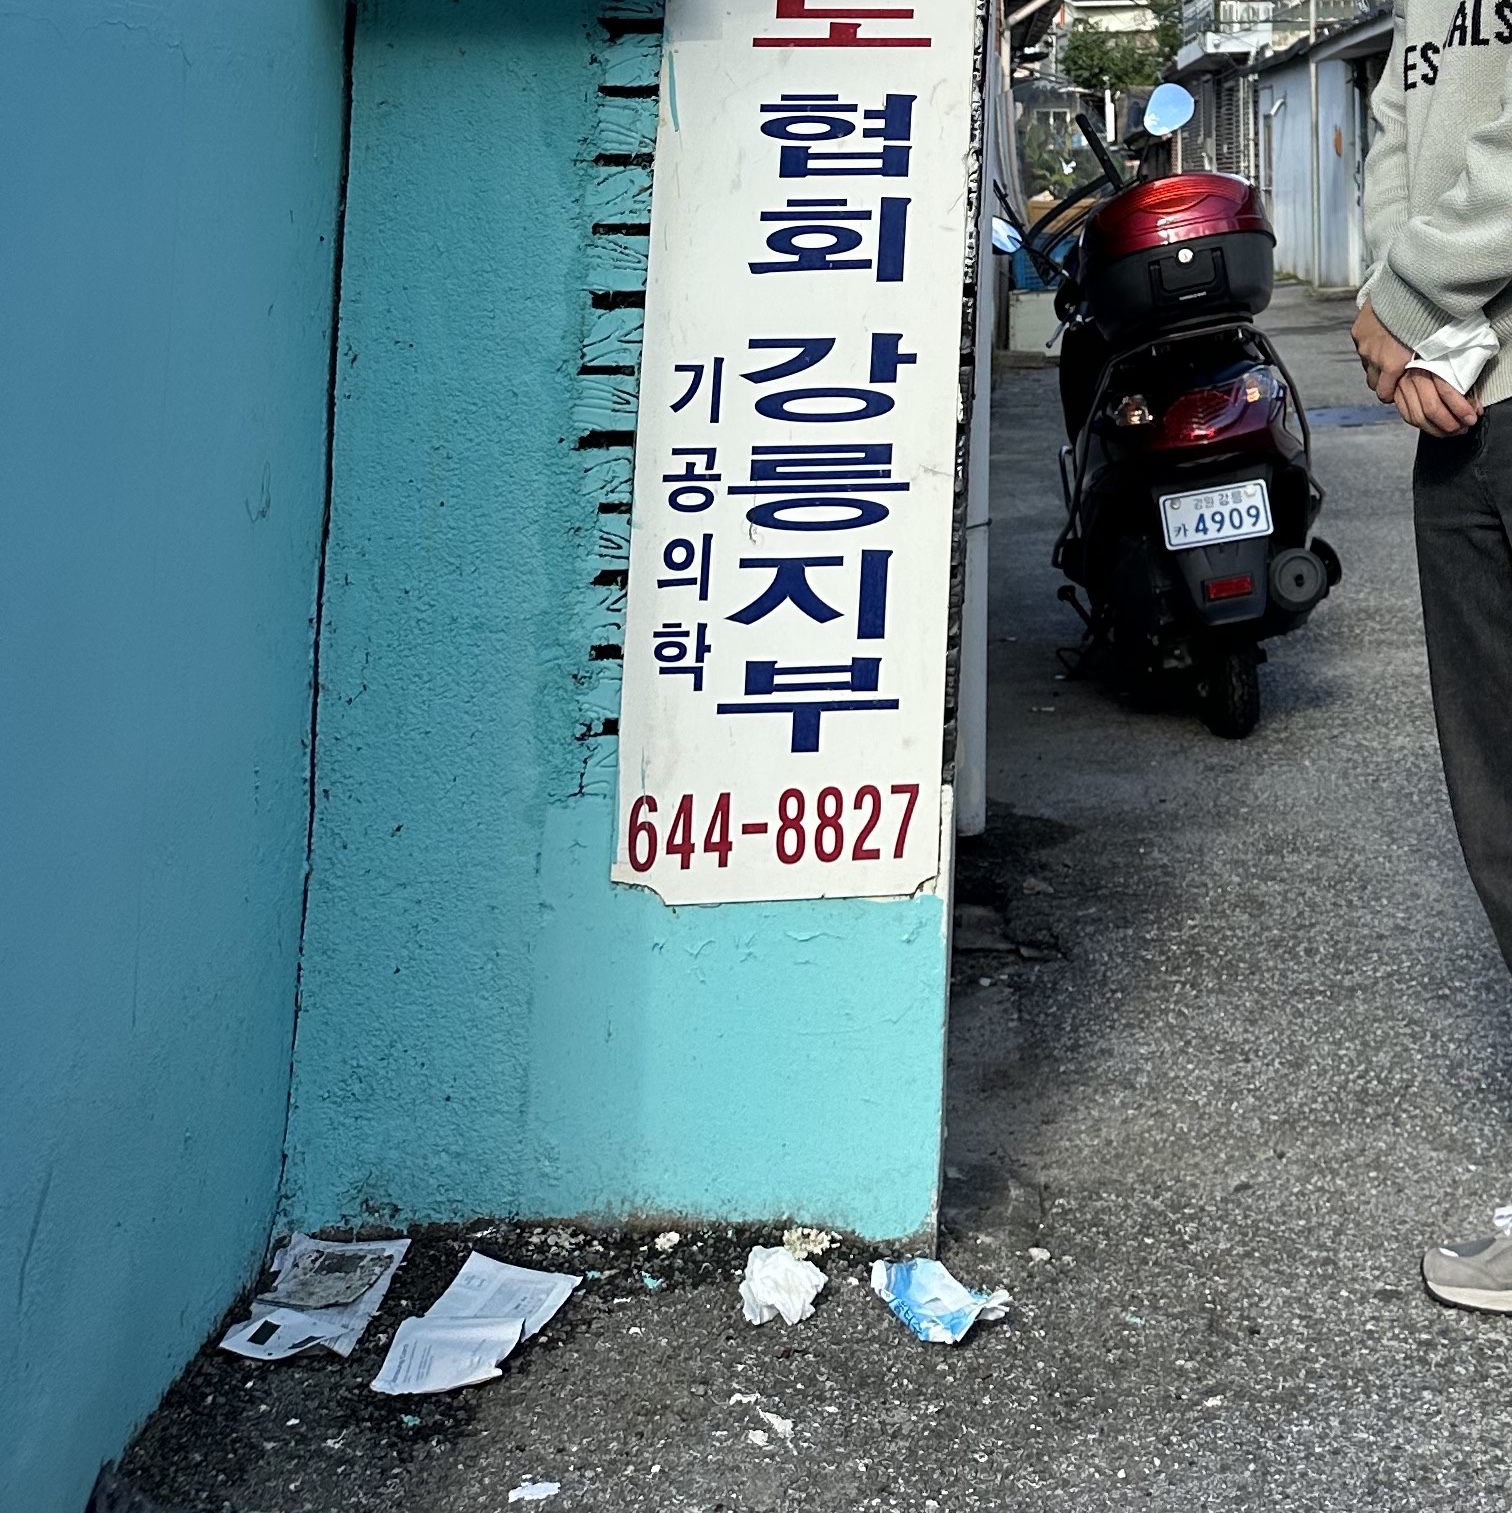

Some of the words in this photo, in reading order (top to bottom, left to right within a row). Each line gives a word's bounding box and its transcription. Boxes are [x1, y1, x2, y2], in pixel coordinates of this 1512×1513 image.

[748, 93, 917, 283] 협회
[652, 356, 725, 692] 기공의학
[716, 332, 918, 753] 강릉지부
[1195, 505, 1261, 535] 4909
[627, 783, 921, 873] 644-8827
